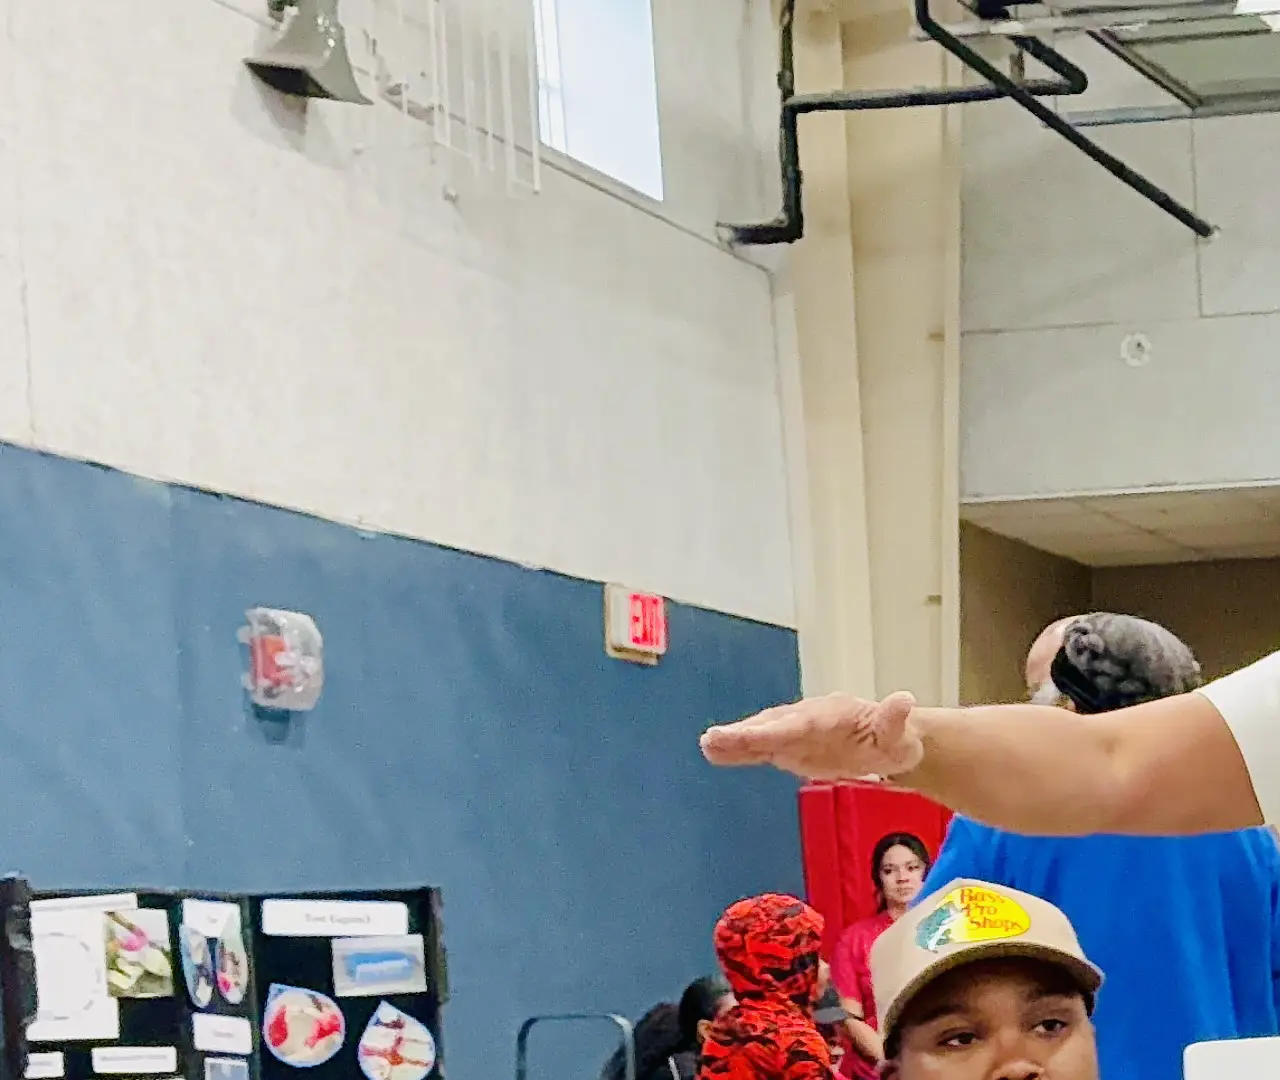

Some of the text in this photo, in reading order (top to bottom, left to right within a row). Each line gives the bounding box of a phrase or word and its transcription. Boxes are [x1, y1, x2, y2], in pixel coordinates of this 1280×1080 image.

[961, 888, 1005, 904] Bass
[962, 903, 998, 917] Pro
[969, 916, 1025, 932] Shops
